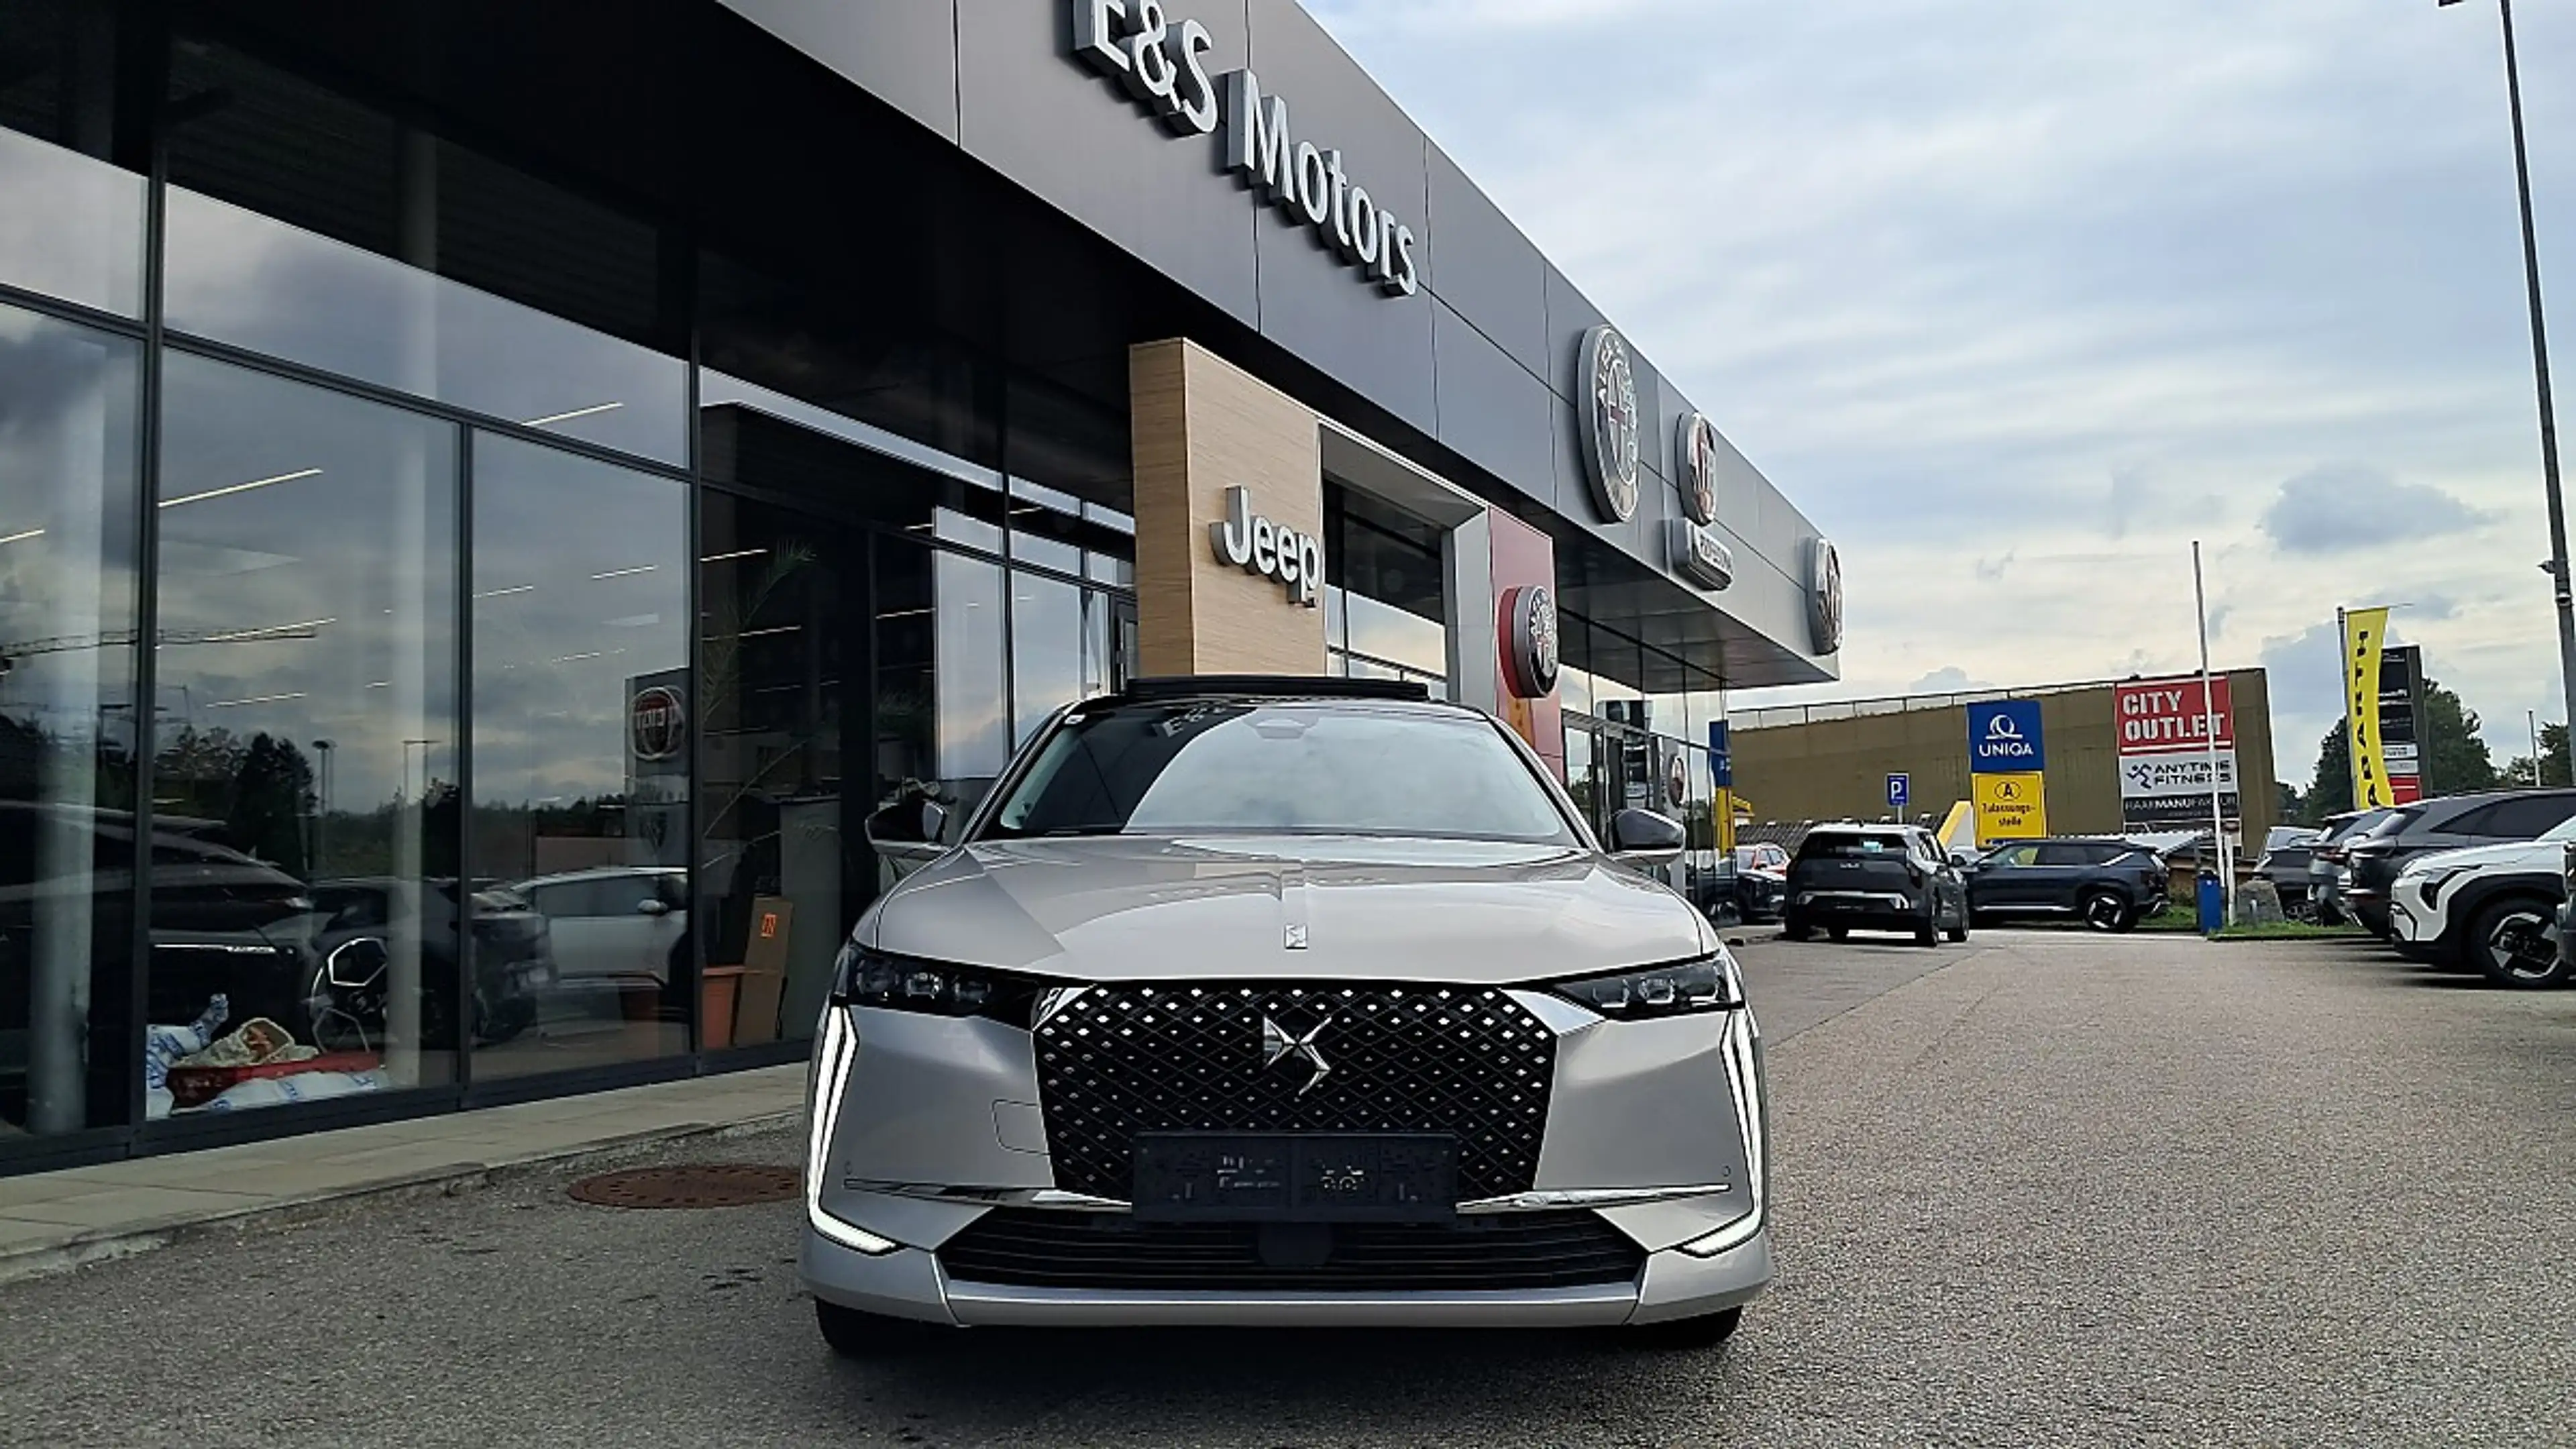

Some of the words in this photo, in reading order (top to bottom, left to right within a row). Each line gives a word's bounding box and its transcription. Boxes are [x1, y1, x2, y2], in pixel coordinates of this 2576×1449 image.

[1240, 68, 1417, 296] Motors
[1217, 485, 1321, 604] Jeep
[2123, 690, 2182, 716] CITY
[2125, 713, 2225, 741] OUTLET
[1978, 742, 2034, 757] UNIQA
[2154, 760, 2231, 773] ANYTIME
[1890, 781, 1903, 800] P
[2003, 783, 2014, 797] A
